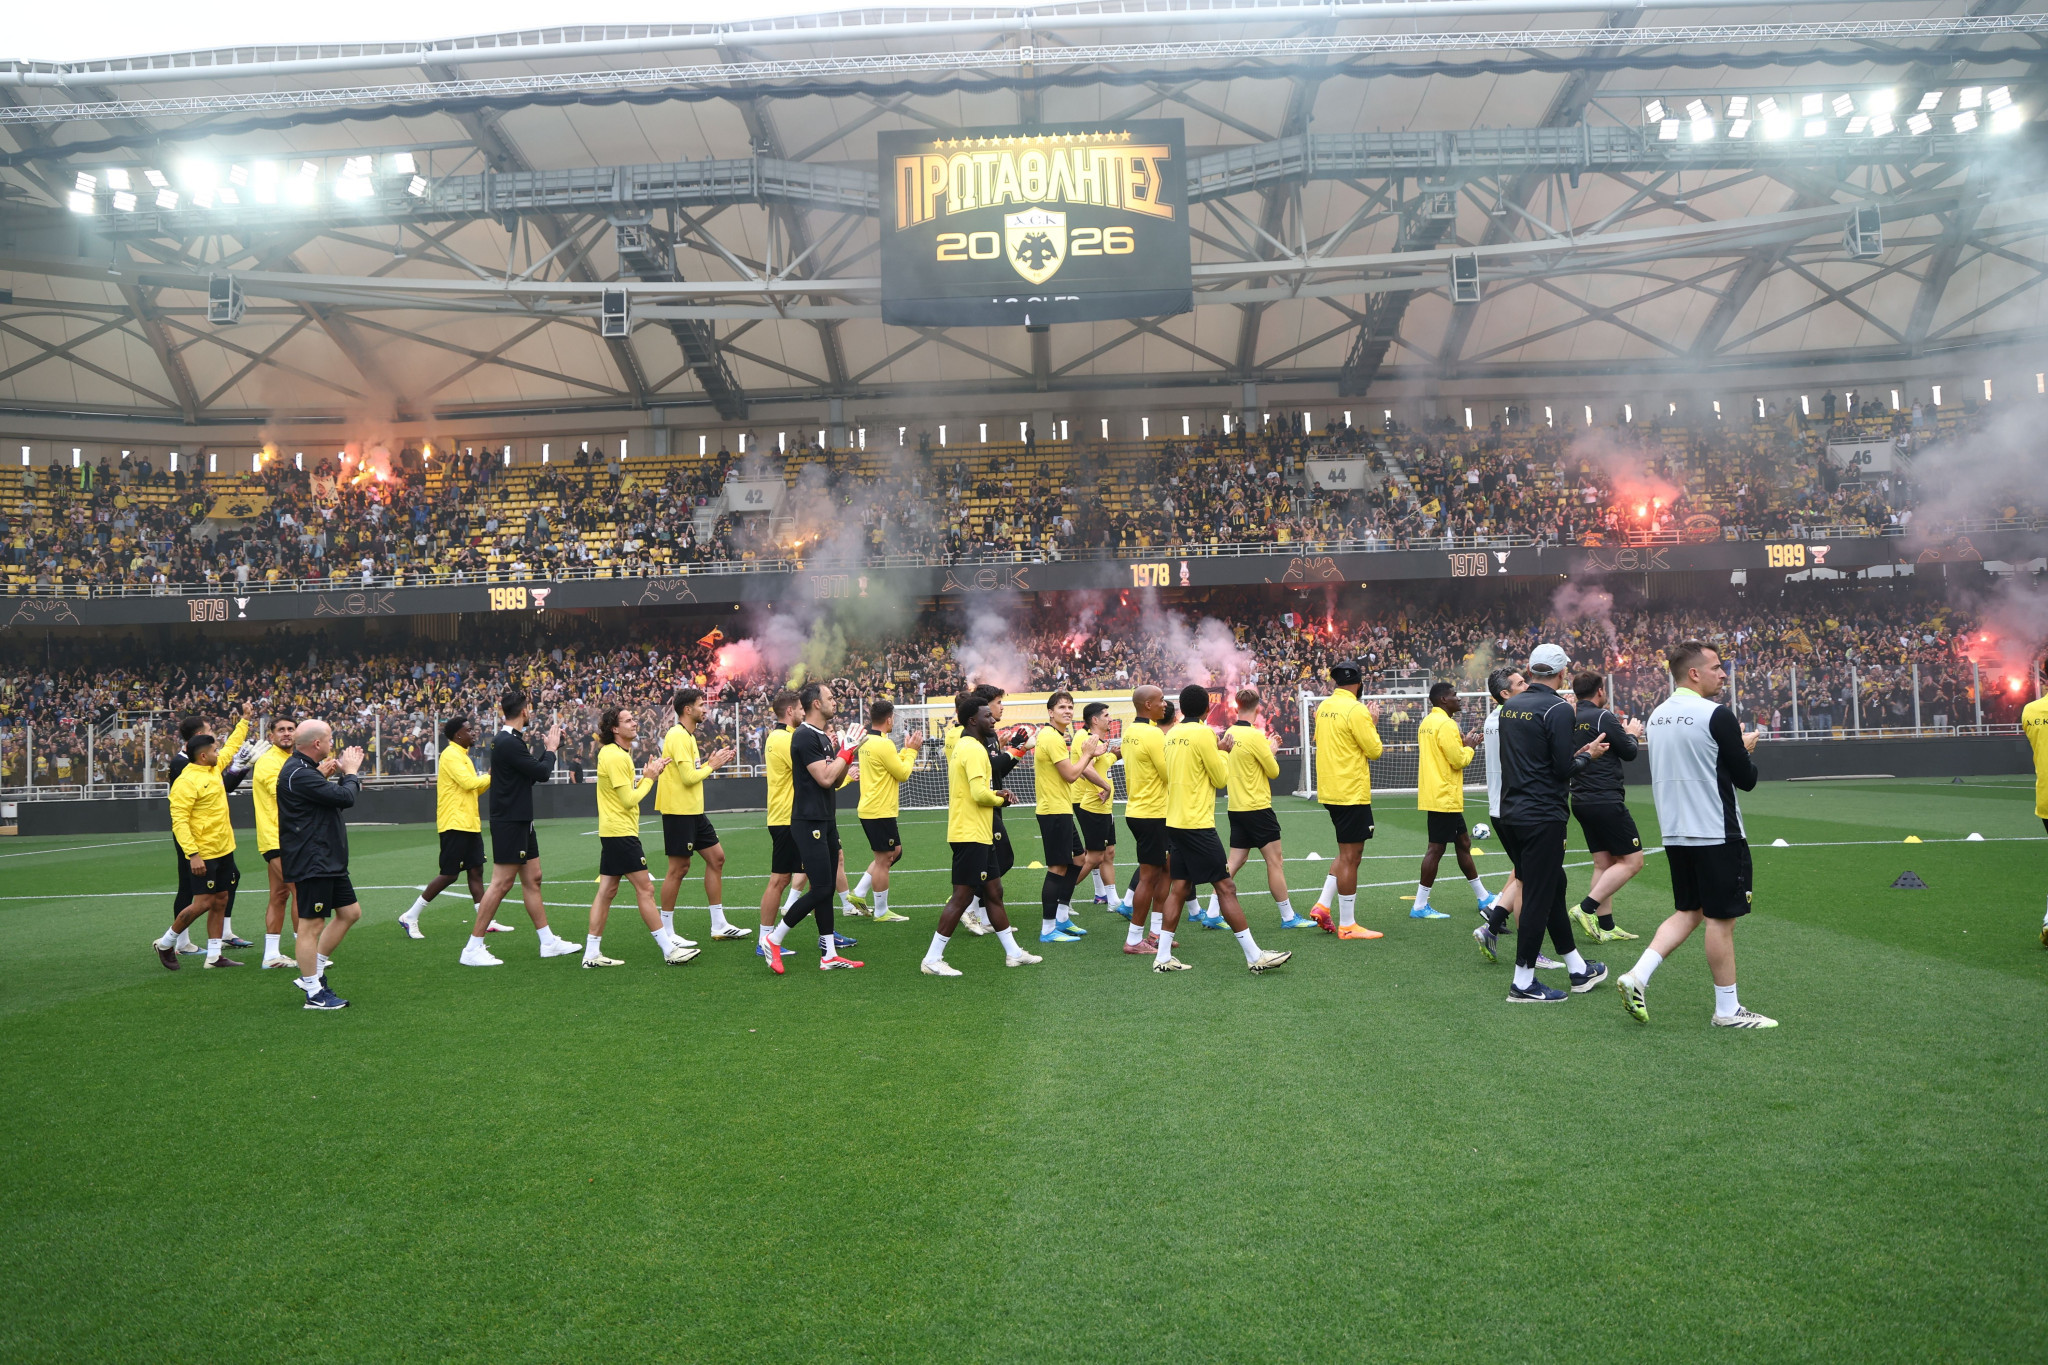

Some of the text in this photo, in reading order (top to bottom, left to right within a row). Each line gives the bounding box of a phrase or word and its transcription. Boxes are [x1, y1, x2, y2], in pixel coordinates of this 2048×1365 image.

[894, 144, 1175, 232] ΠΡΩΤΑΘΛΗΤΕΣ
[936, 226, 1135, 261] 20 26
[1849, 450, 1872, 465] 46
[1327, 468, 1346, 483] 44
[745, 488, 763, 504] 42
[1448, 552, 1488, 577] 1979
[1765, 543, 1805, 568] 1989
[1130, 562, 1170, 587] 1978
[488, 586, 527, 611] 1989
[187, 598, 228, 622] 1979
[1520, 712, 1533, 721] FC
[1676, 716, 1694, 726] FC
[1579, 723, 1590, 731] FC
[1179, 738, 1190, 747] FC
